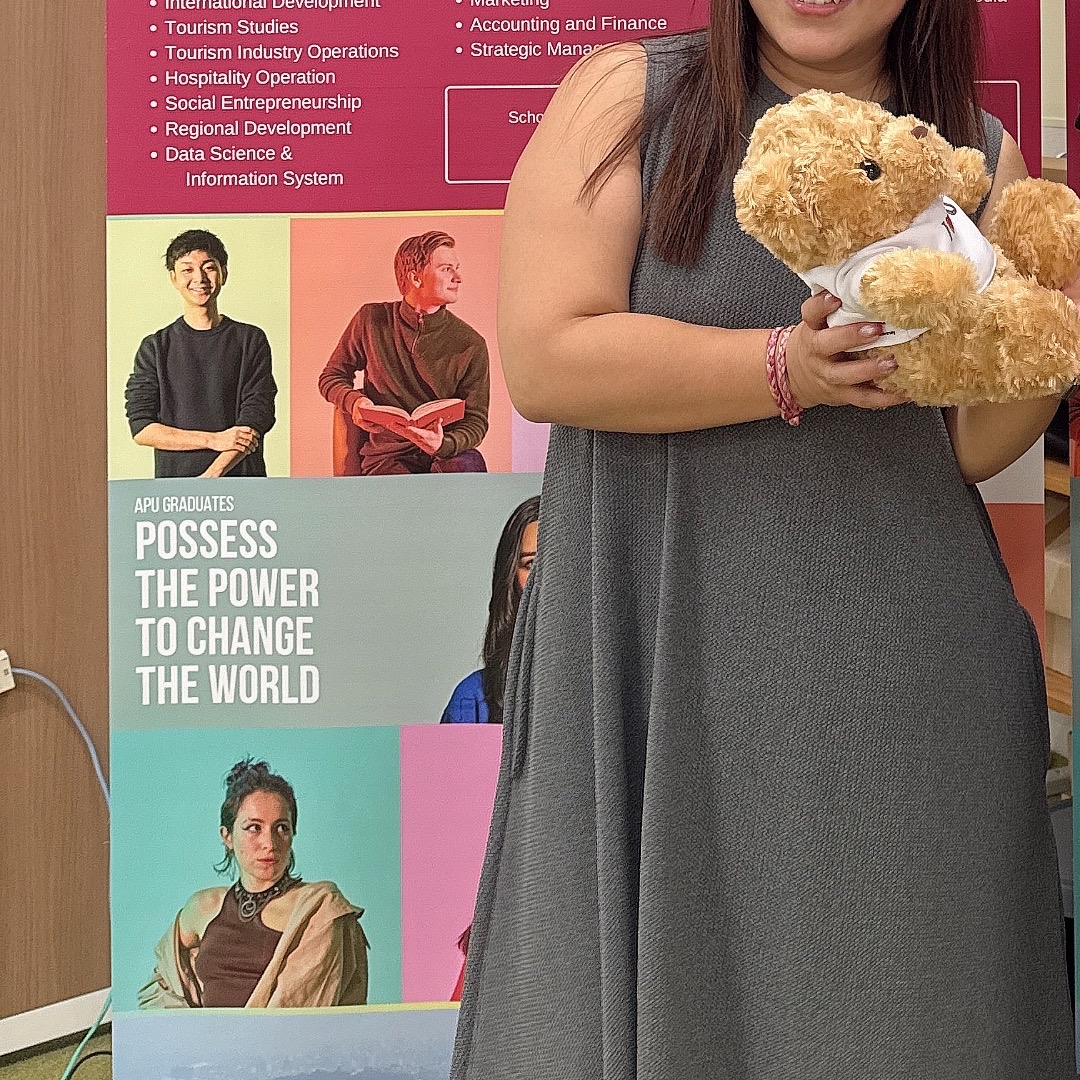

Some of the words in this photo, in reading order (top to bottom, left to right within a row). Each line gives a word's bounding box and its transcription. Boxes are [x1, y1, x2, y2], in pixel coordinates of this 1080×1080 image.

[165, 20, 232, 35] Tourism
[237, 19, 299, 34] Studies
[469, 16, 560, 35] Accounting
[565, 16, 596, 31] and
[601, 16, 667, 31] Finance
[165, 45, 233, 61] Tourism
[237, 44, 303, 63] Industry
[307, 43, 400, 62] Operations
[470, 42, 542, 60] Strategic
[165, 70, 251, 88] Hospitality
[255, 69, 336, 88] Operation
[165, 95, 216, 111] Social
[220, 93, 363, 113] Entrepreneurship
[165, 121, 239, 139] Regional
[243, 120, 352, 138] Development
[165, 146, 206, 162] Data
[209, 146, 276, 162] Science
[280, 146, 293, 160] &
[186, 171, 278, 187] Information
[283, 171, 344, 189] System
[133, 496, 160, 514] APU
[162, 495, 235, 513] GRADUATES
[135, 518, 279, 560] POSSESS
[134, 568, 199, 609] THE
[208, 567, 320, 608] POWER
[134, 617, 178, 657] TO
[186, 615, 315, 657] CHANGE
[135, 665, 200, 706] THE
[208, 664, 321, 705] WORLD
